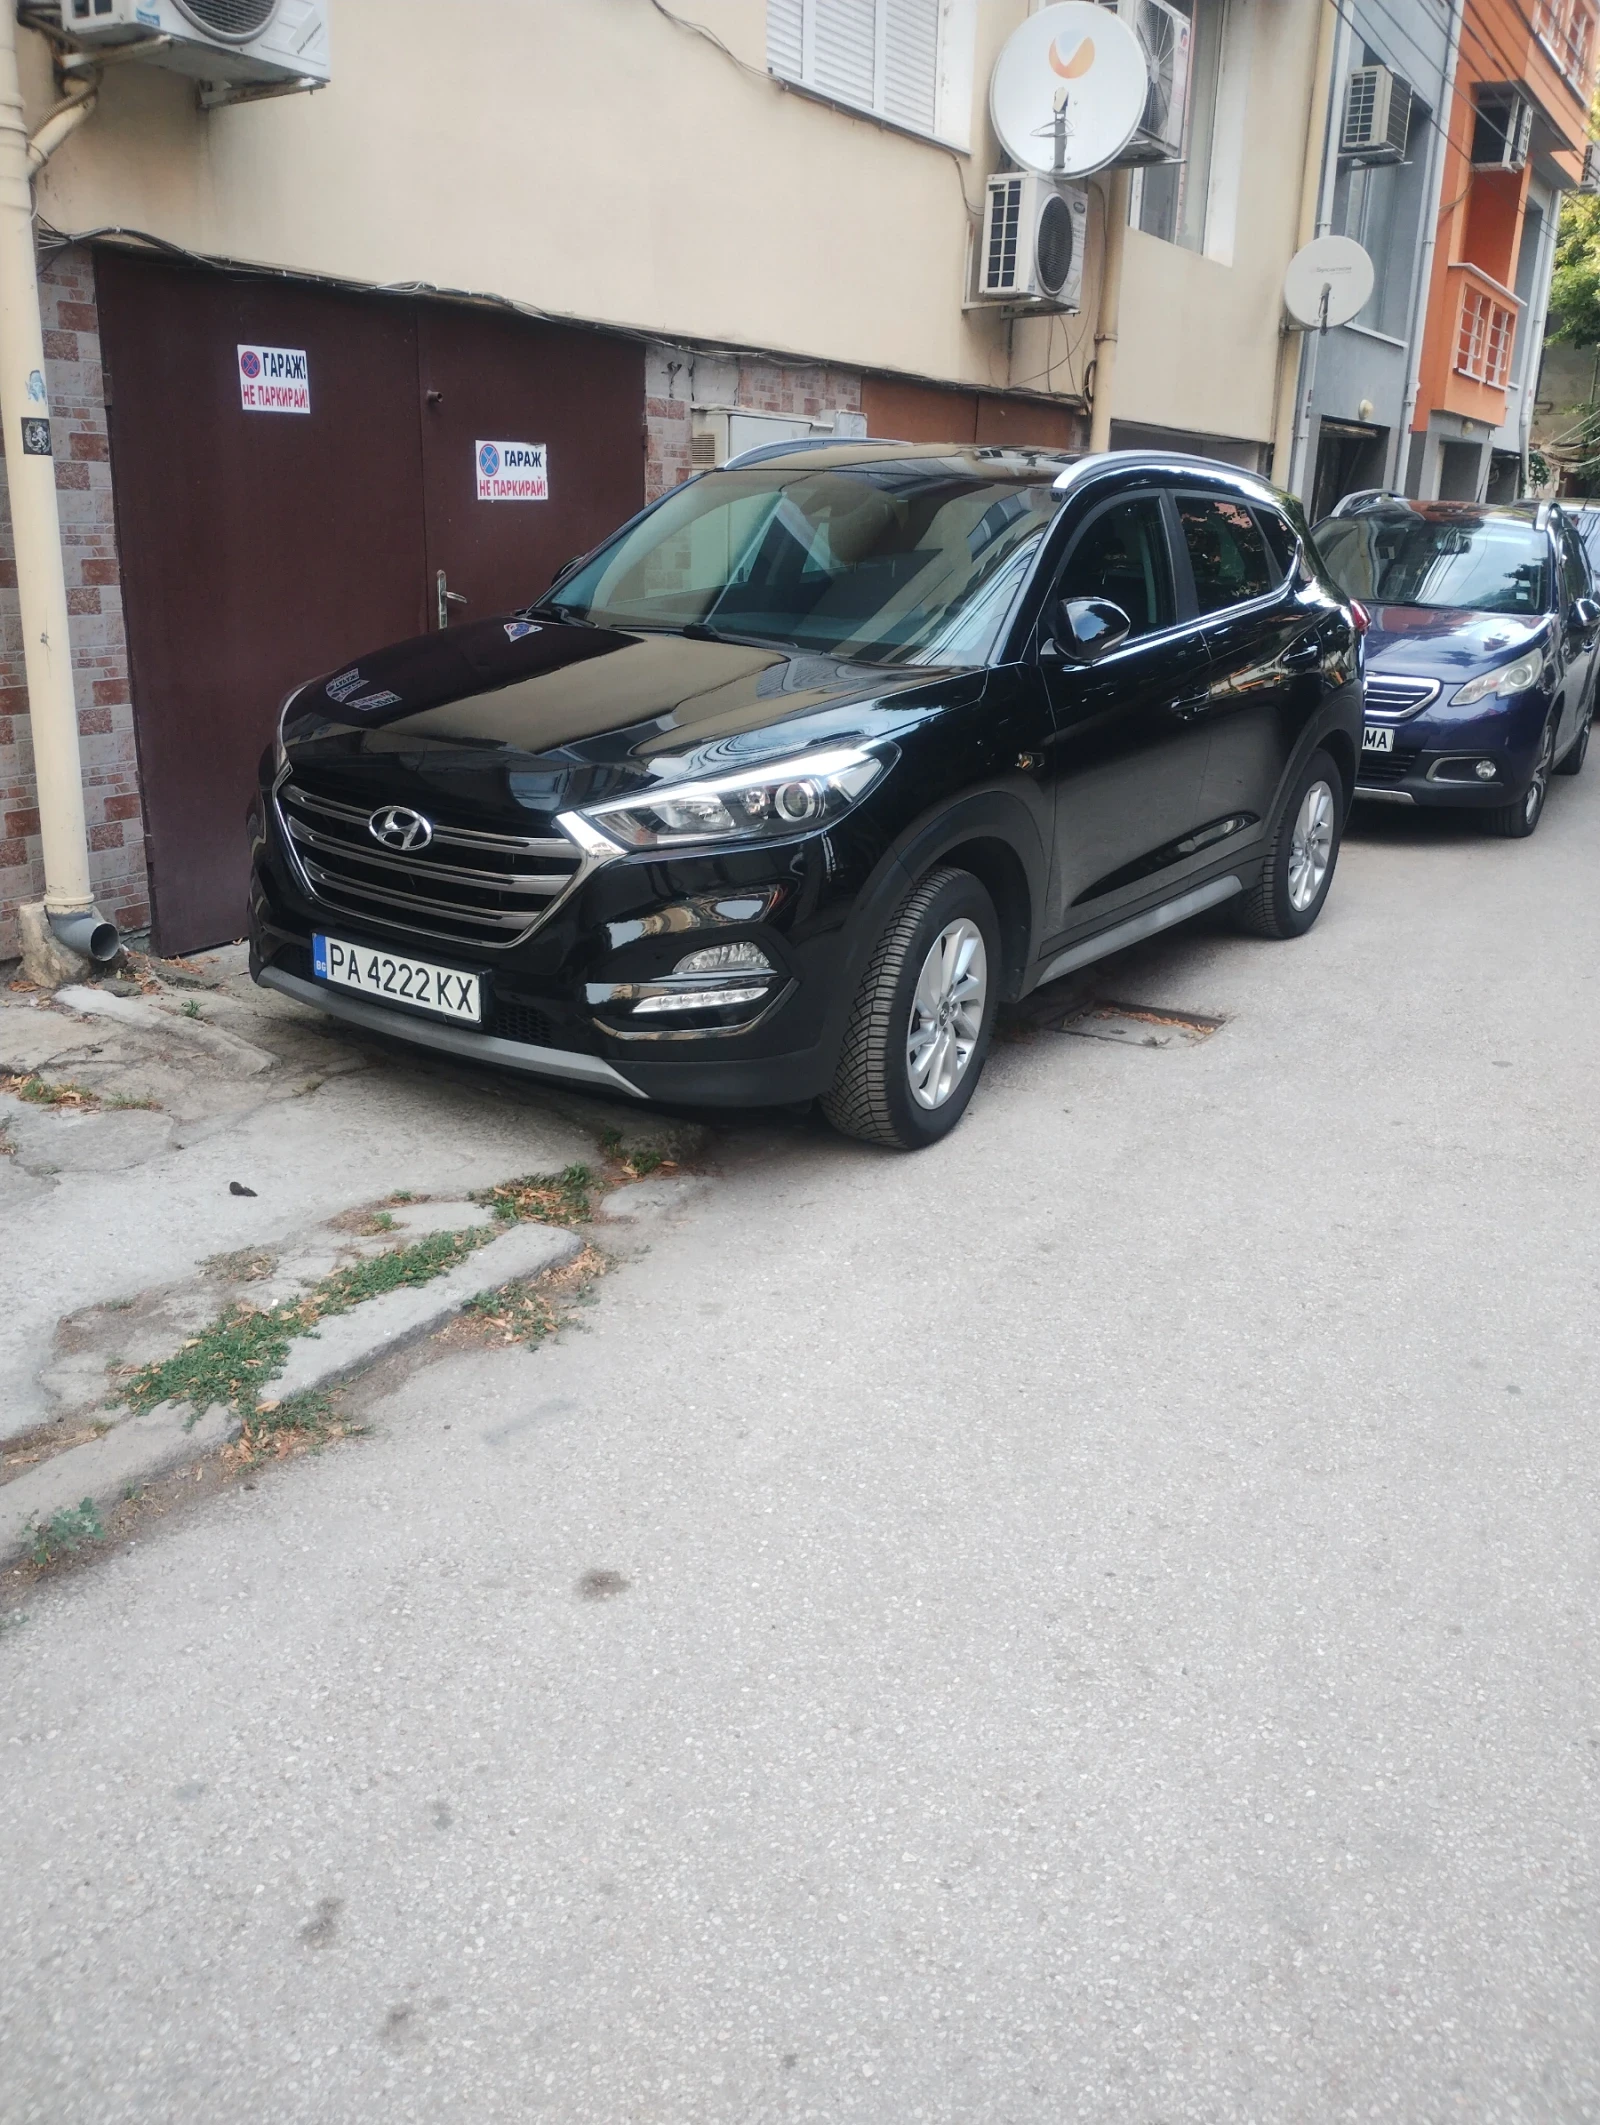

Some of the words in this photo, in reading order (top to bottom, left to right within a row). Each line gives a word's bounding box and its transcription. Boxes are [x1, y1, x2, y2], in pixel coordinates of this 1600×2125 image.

[262, 352, 307, 380] ГАРАЖ!
[242, 384, 256, 405] НЕ
[257, 384, 309, 409] ПАРКИРАЙ!
[504, 450, 542, 468] ГАРАЖ
[479, 480, 491, 497] НЕ
[493, 475, 546, 497] ПАРКИРАЙ!
[1363, 729, 1388, 749] MA
[316, 960, 327, 972] BG
